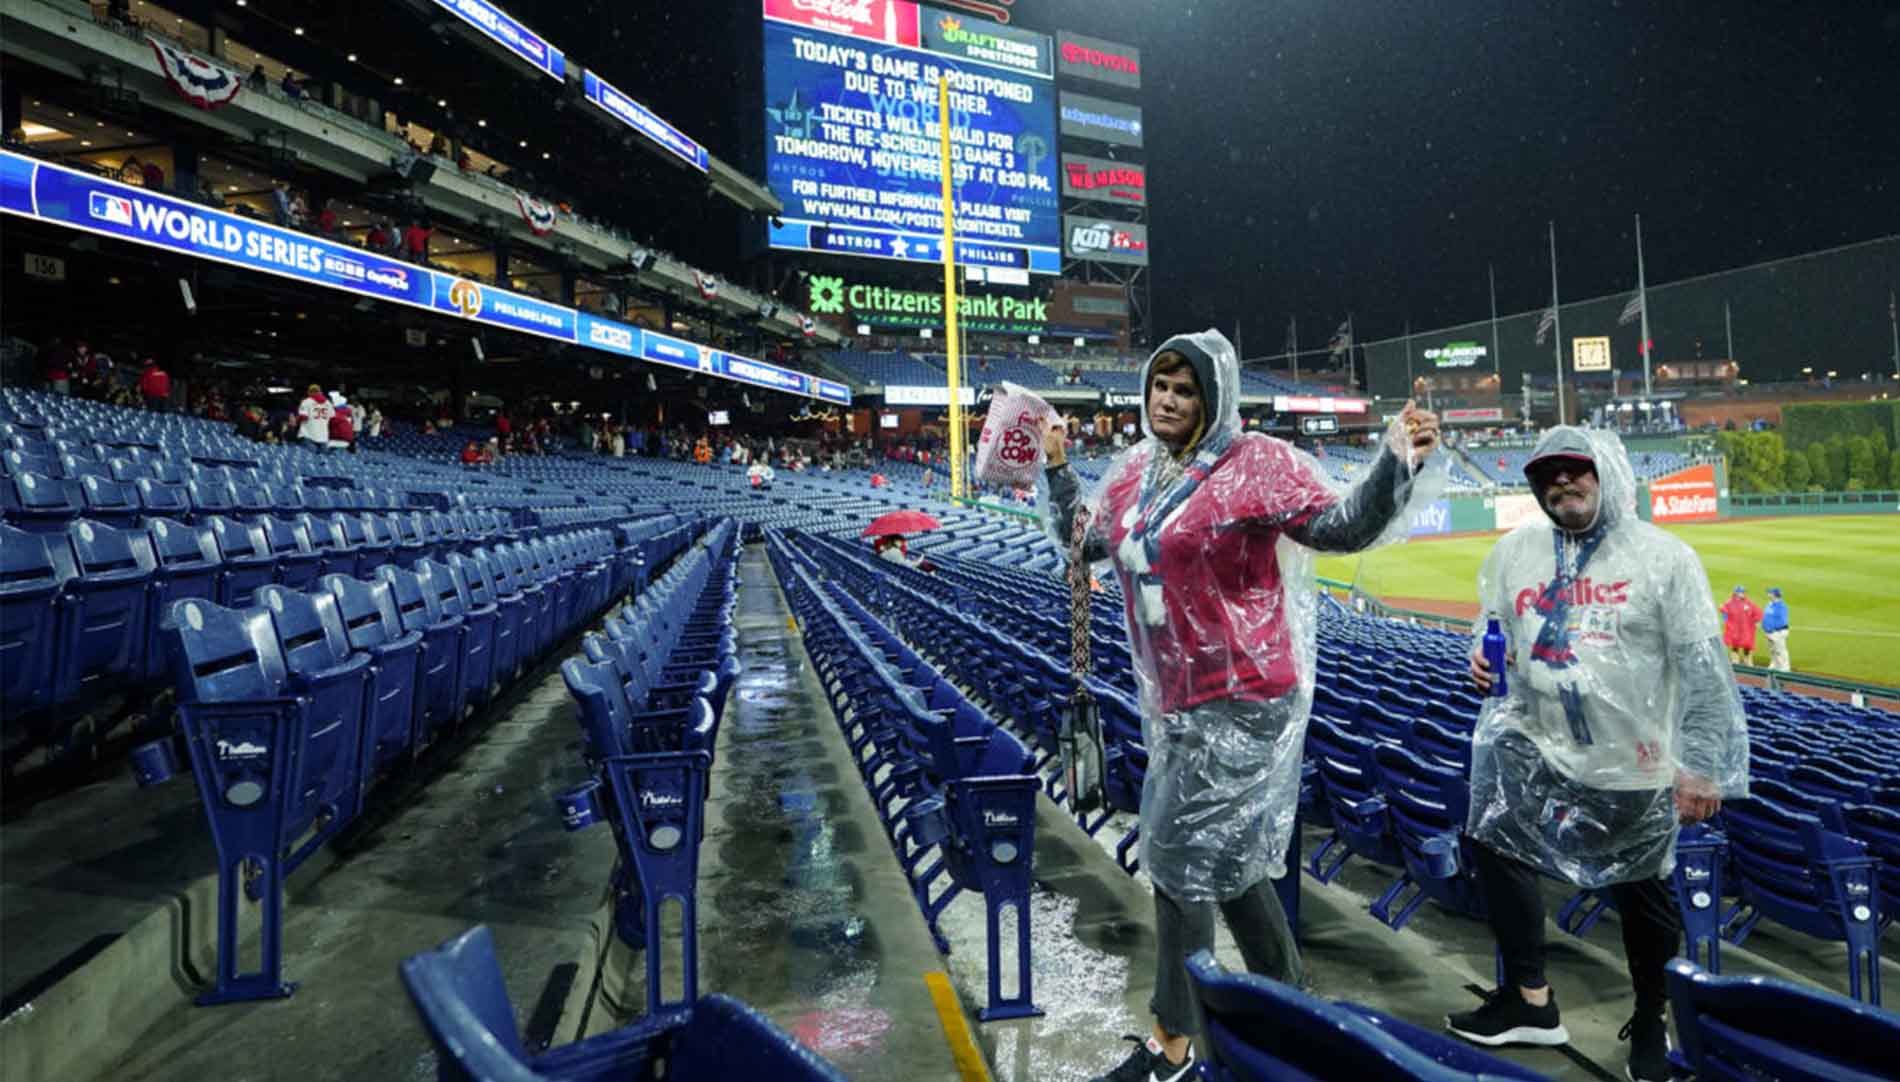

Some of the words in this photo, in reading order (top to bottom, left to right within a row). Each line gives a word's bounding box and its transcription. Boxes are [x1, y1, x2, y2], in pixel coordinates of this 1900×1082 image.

[943, 29, 1038, 58] DRAFTKINGS
[1080, 48, 1139, 75] TOYOTA
[792, 37, 867, 71] TODAY'S
[871, 53, 919, 81] GAME
[923, 64, 940, 86] IS
[944, 68, 1033, 104] POSTPONED
[845, 70, 880, 96] DUE
[884, 78, 906, 100] TO
[911, 83, 992, 117] WETHER.
[868, 89, 971, 130] WORD
[820, 102, 882, 130] TICKETS
[886, 112, 919, 136] WILL
[924, 121, 944, 141] BE
[948, 126, 985, 147] VALID
[987, 132, 1014, 152] FOR
[820, 122, 851, 145] THE
[854, 128, 962, 161] RE-SCHEDULD
[964, 146, 1002, 168] GAME
[1004, 153, 1015, 170] 3
[772, 162, 827, 178] ASTROS
[774, 135, 868, 170] TOMORROW,
[870, 149, 944, 177] NOVEMBE
[951, 163, 977, 183] 1ST
[979, 167, 995, 184] AT
[997, 169, 1027, 188] 8:00
[1028, 173, 1053, 193] PM.
[792, 178, 818, 197] FOR
[820, 181, 877, 204] FURTHER
[879, 190, 959, 217] INFORMATI,
[961, 200, 1004, 219] PLEASE
[1003, 207, 1032, 224] VISIT
[802, 198, 1025, 239] WWW.MLB.COM/POSTSSONTICKETS.
[133, 197, 243, 254] WORLD
[245, 230, 325, 274] SERIES
[827, 234, 882, 249] ASTROS
[960, 247, 1015, 264] PHILLIES
[494, 301, 563, 328] PHILADELPHIA
[849, 284, 942, 315] Citizens
[1002, 295, 1048, 322] Park
